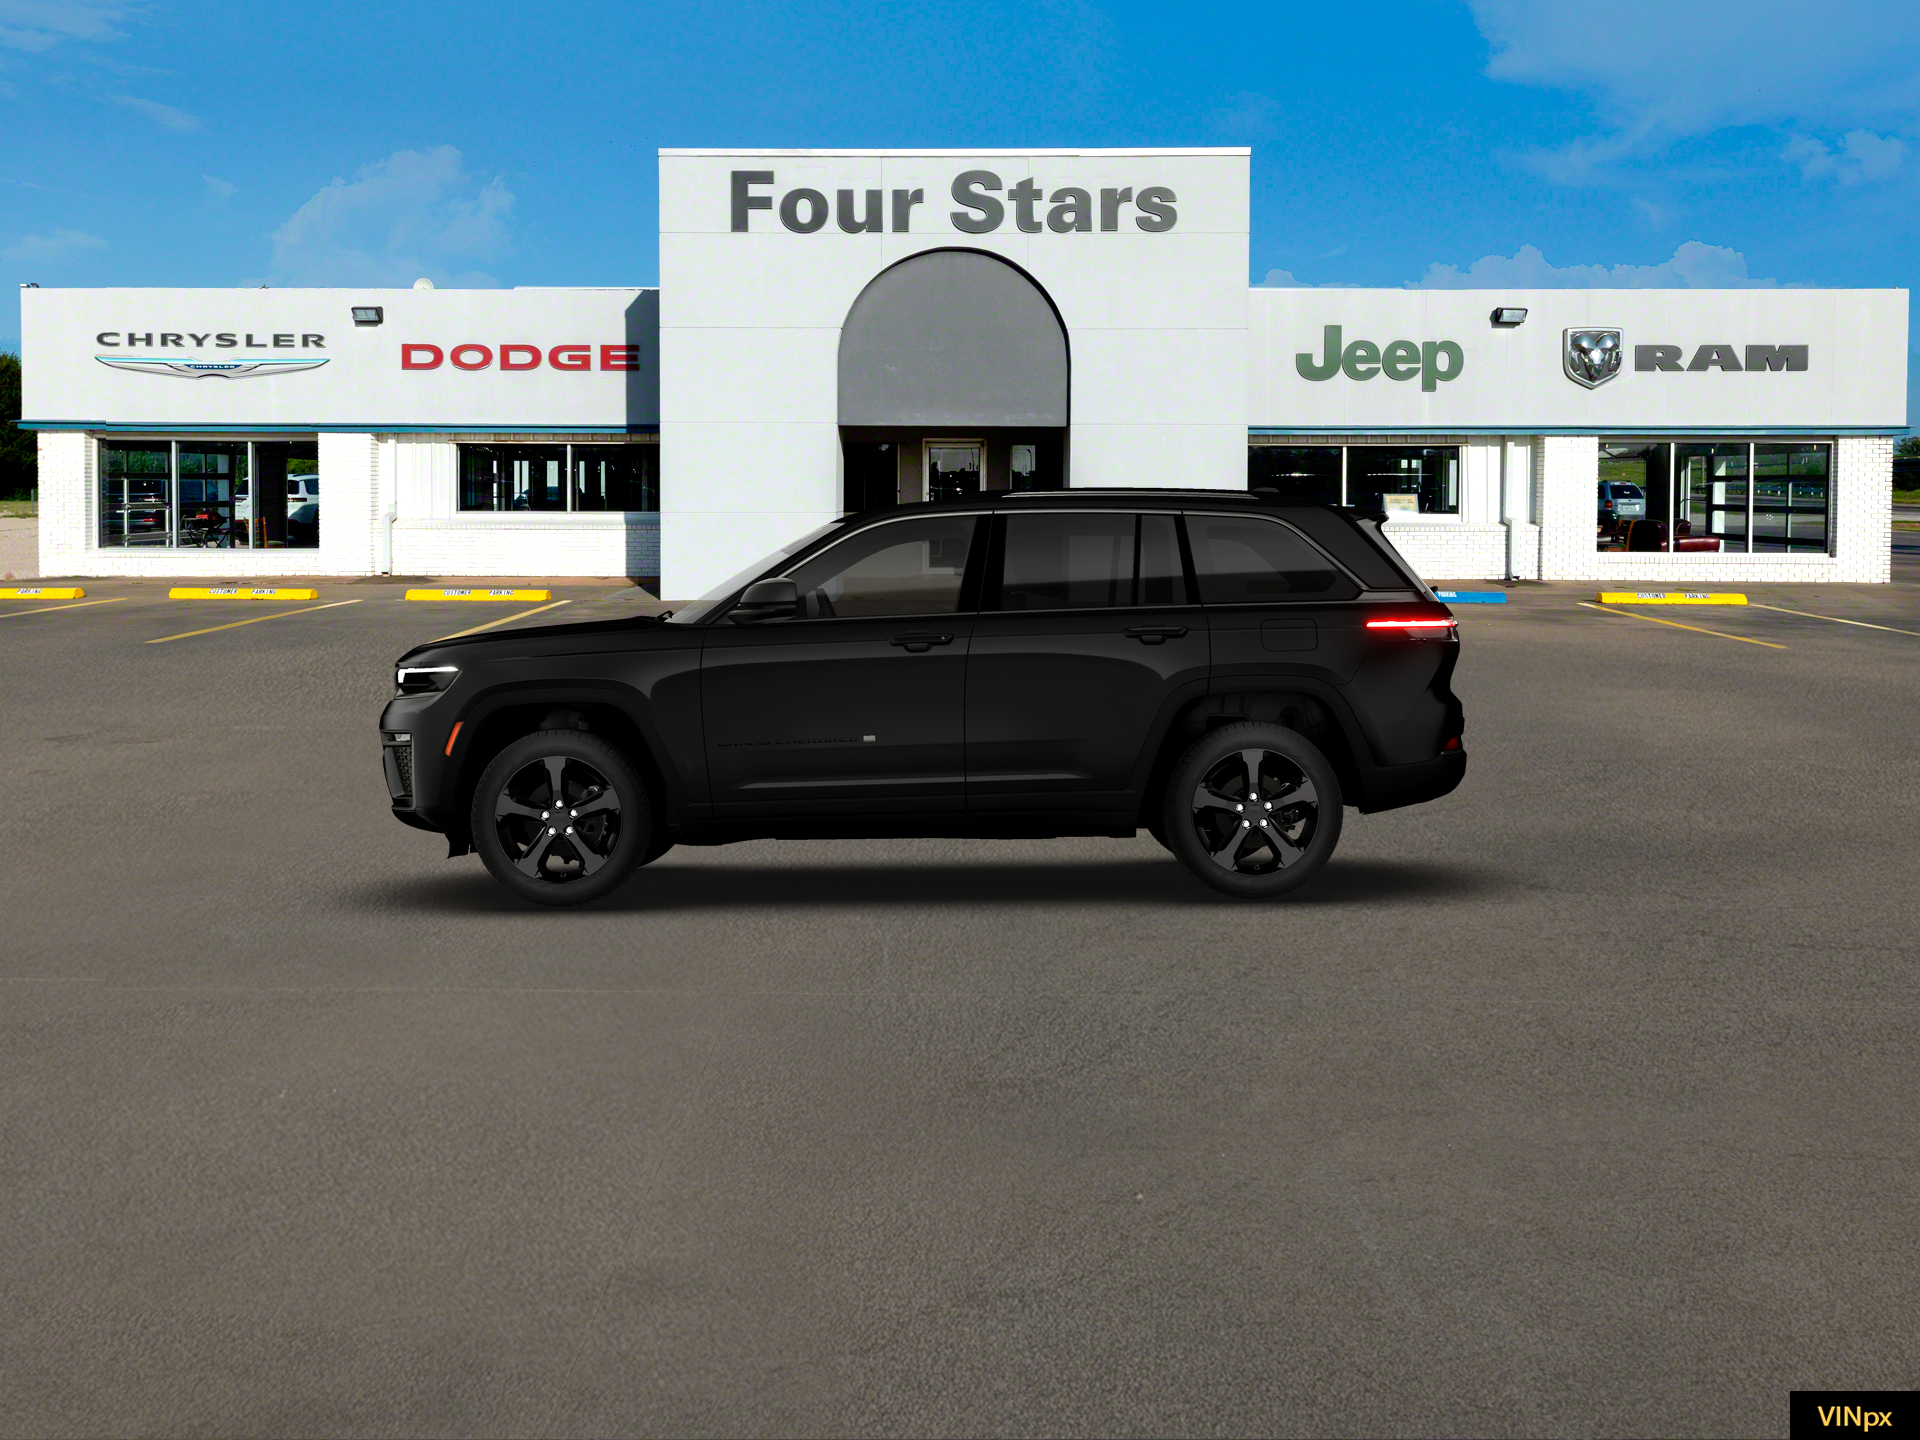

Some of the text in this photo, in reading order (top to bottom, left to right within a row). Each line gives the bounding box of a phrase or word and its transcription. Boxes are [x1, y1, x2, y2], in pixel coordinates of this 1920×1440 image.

[730, 168, 1178, 234] Four Stars
[96, 331, 327, 349] CHRYSLER
[401, 343, 640, 371] DODGE
[1295, 324, 1465, 392] Jeep
[1634, 344, 1809, 371] RAM
